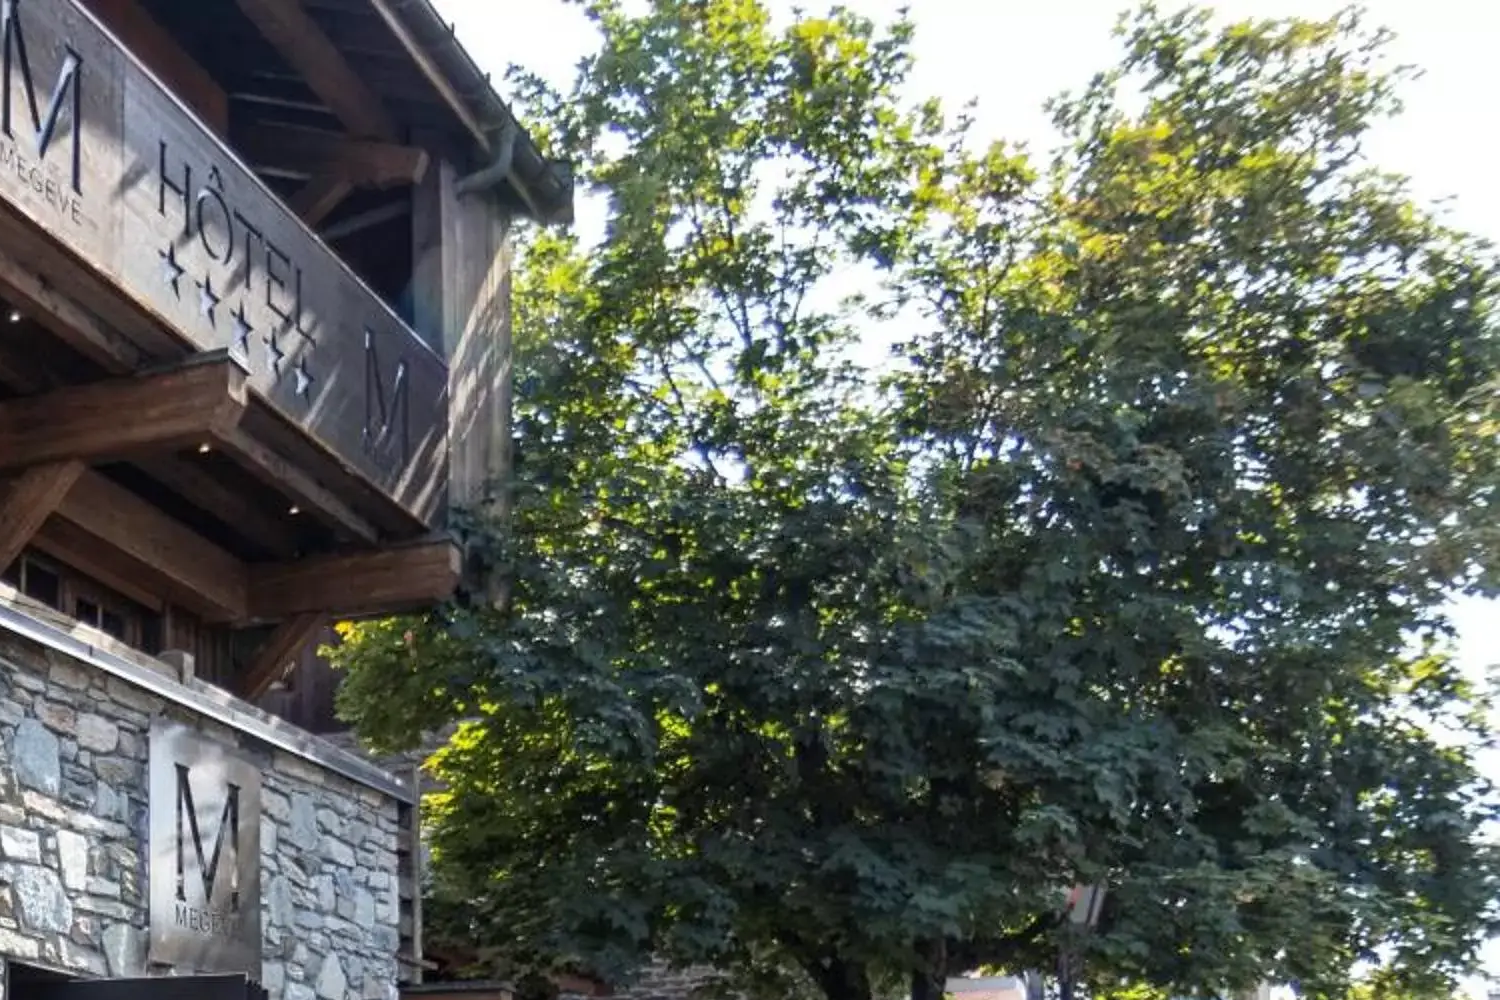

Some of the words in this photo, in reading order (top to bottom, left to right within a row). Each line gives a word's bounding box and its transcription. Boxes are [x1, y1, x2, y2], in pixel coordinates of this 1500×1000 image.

[0, 0, 84, 196] M
[155, 137, 318, 349] HÔTEL
[174, 761, 242, 912] M
